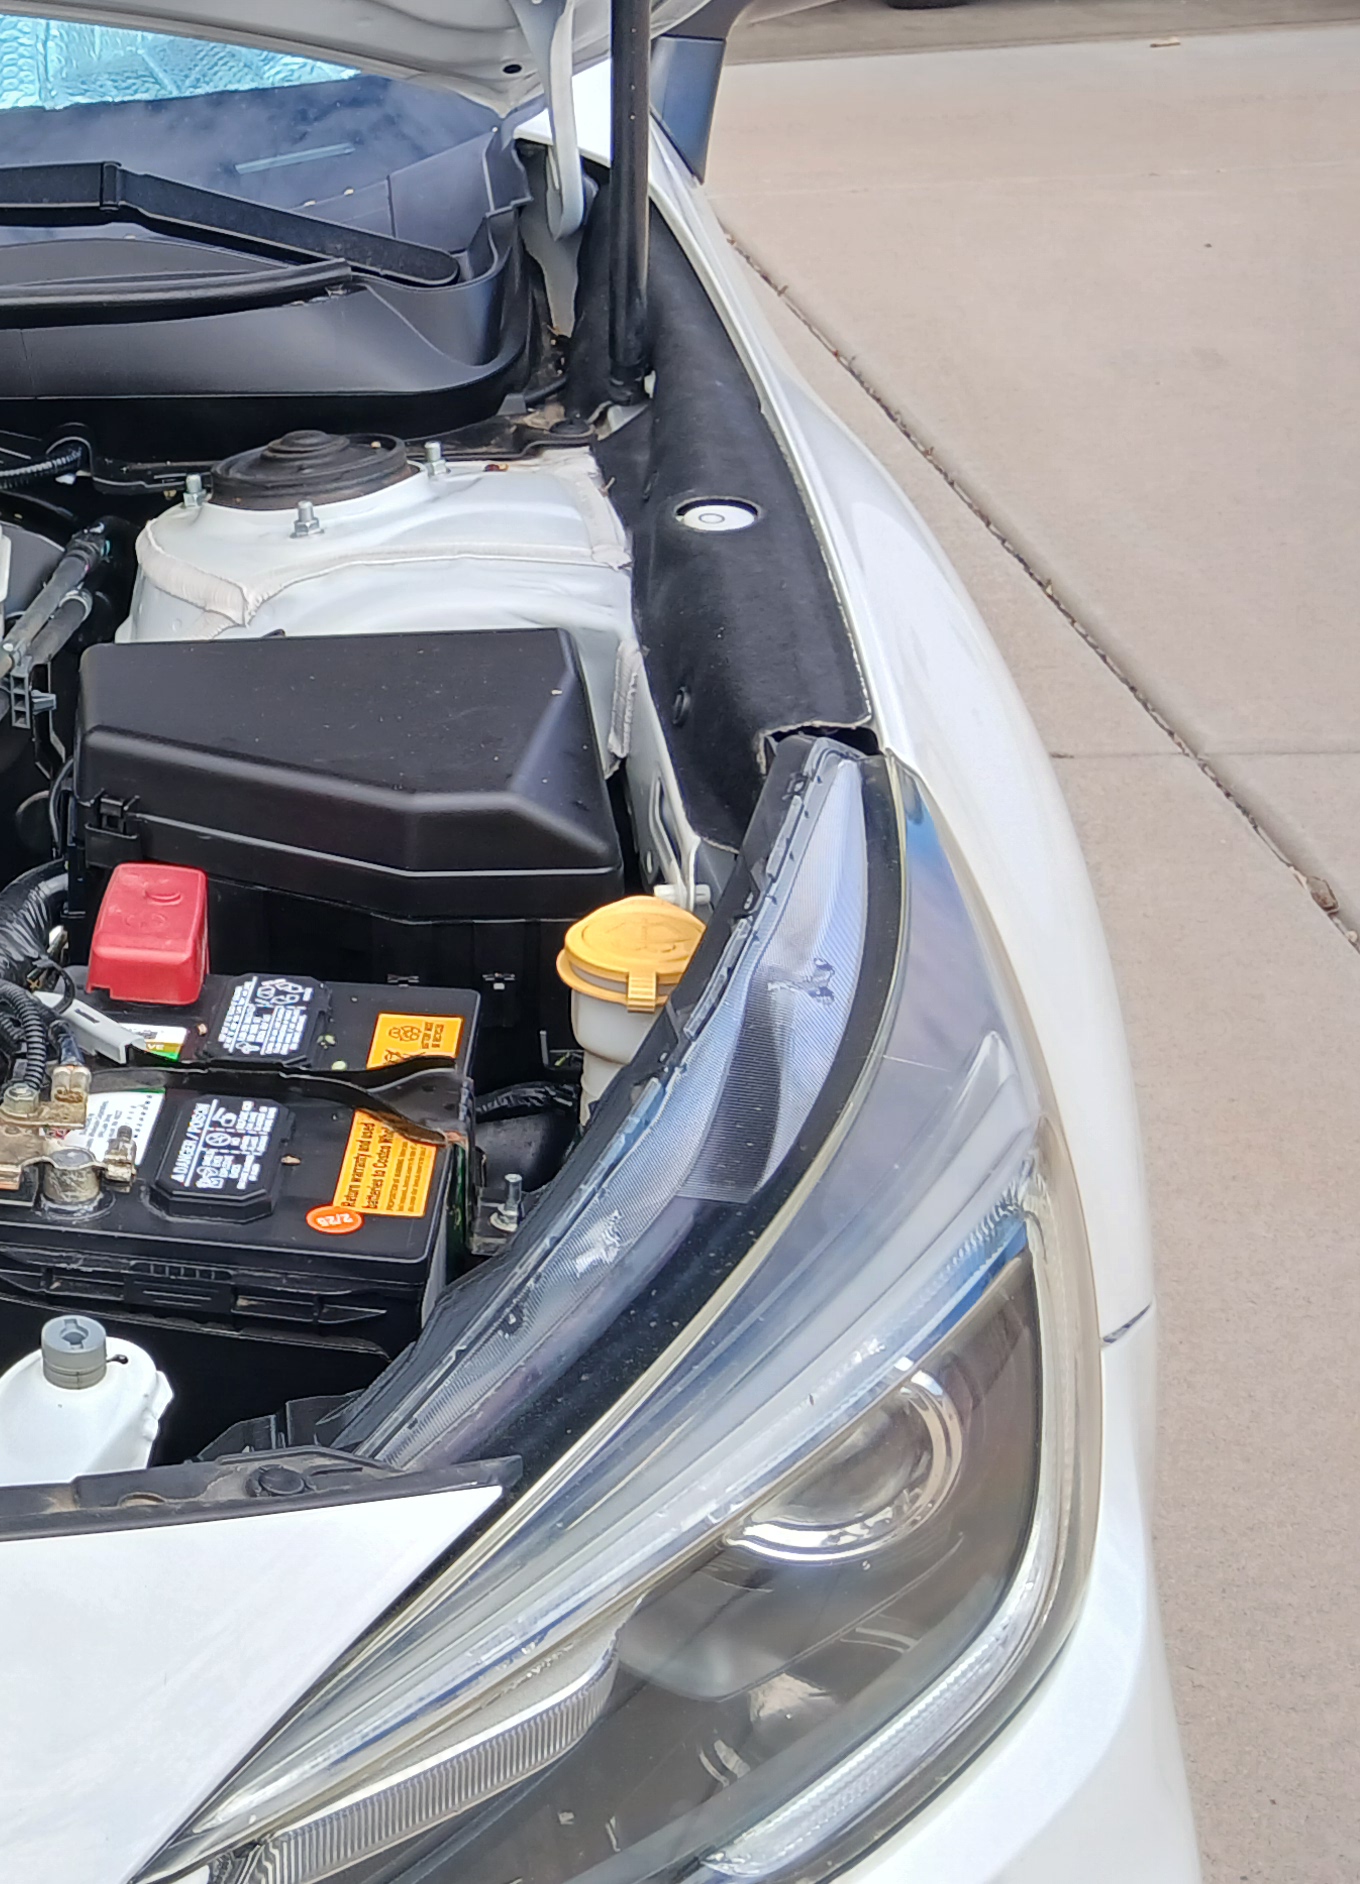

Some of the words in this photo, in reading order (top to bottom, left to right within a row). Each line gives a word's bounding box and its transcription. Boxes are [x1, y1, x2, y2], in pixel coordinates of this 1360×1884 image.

[357, 1122, 375, 1139] used
[356, 1140, 371, 1152] and
[373, 1145, 392, 1169] Costco
[351, 1152, 374, 1182] warranty
[371, 1170, 386, 1178] to
[341, 1184, 361, 1207] Return
[362, 1179, 384, 1209] batteries
